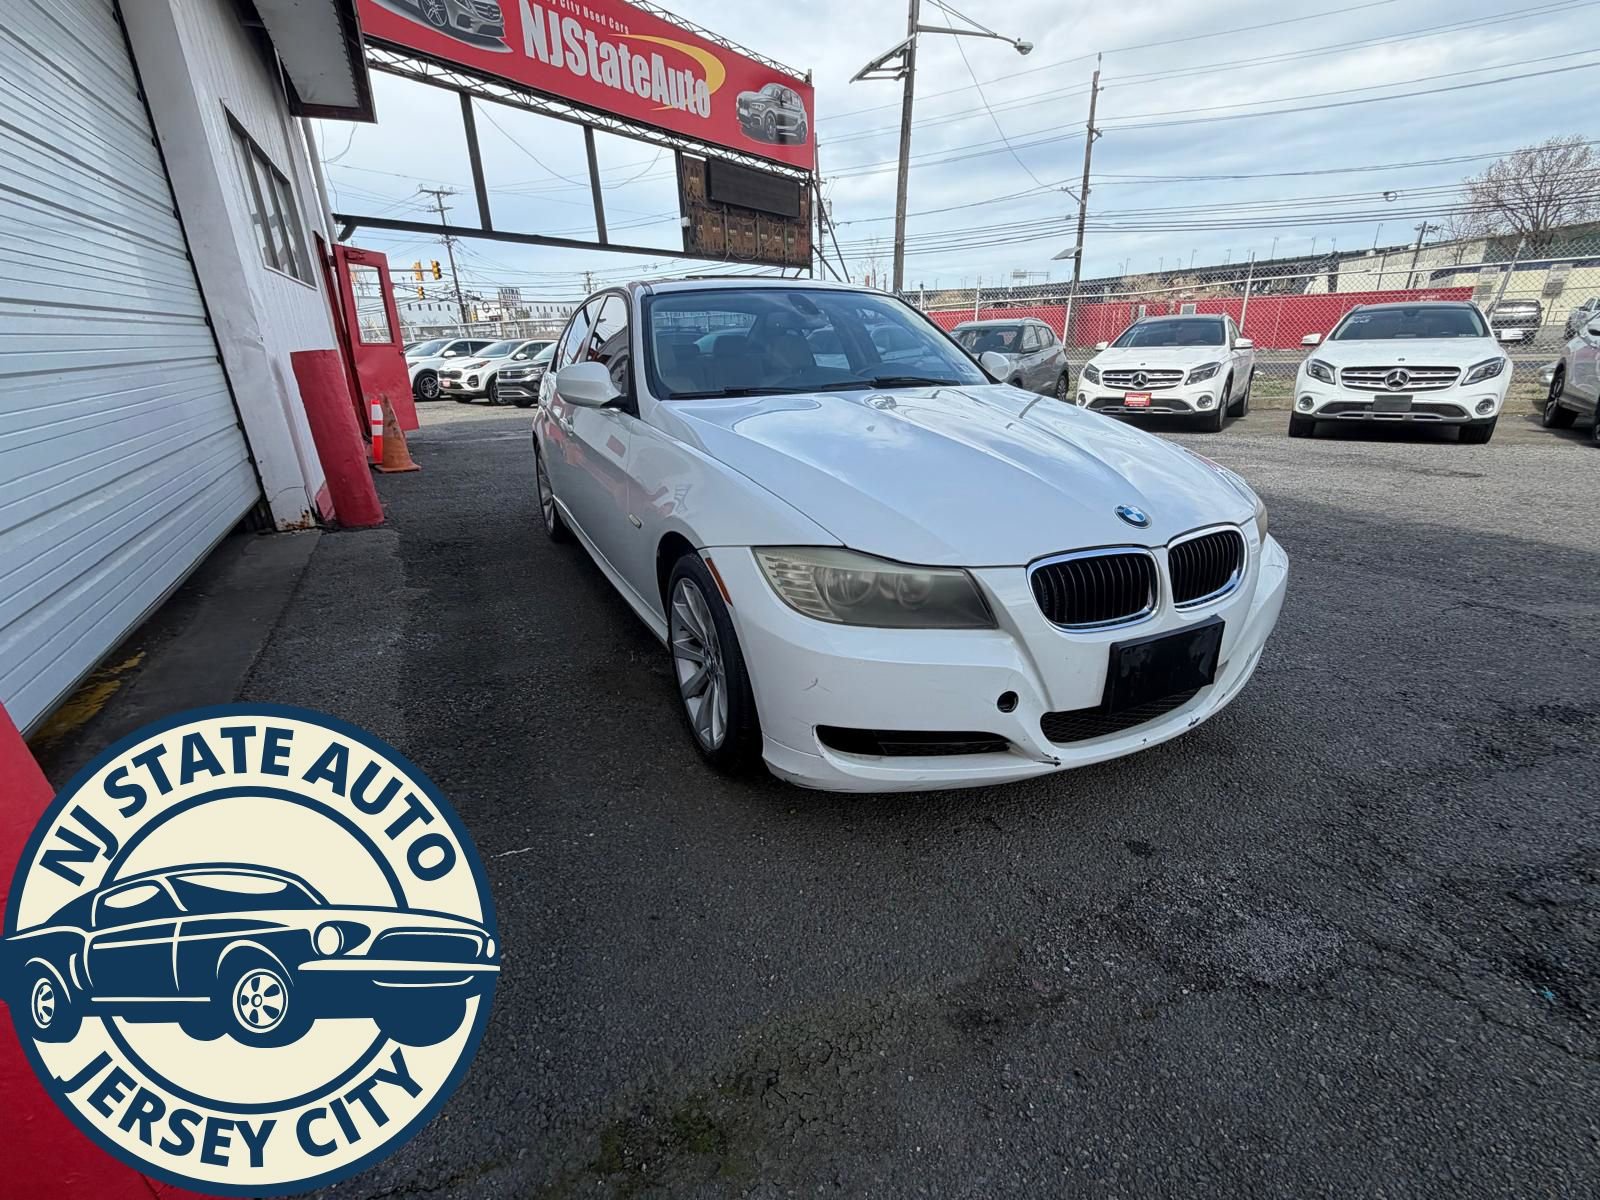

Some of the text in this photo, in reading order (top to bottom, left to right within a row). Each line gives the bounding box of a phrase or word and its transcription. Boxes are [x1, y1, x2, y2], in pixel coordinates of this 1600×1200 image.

[583, 6, 606, 26] Used
[609, 17, 629, 35] Cars
[518, 0, 711, 119] NJStateAuto
